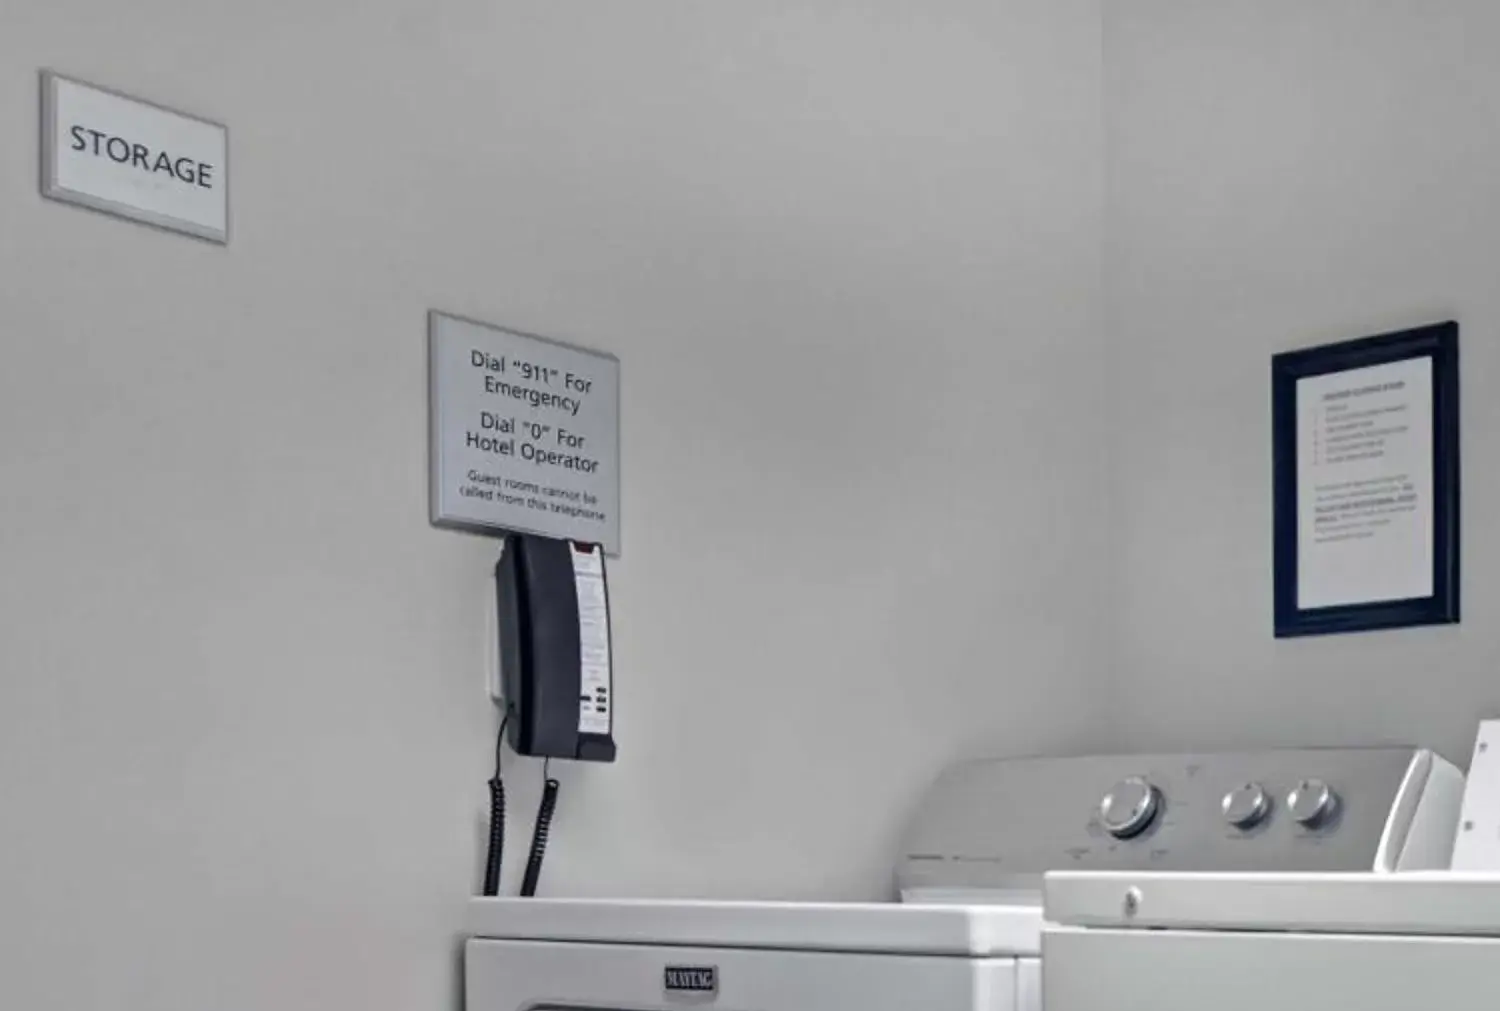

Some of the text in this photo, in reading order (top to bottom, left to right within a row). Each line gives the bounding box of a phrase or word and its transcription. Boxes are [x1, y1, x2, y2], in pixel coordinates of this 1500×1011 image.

[71, 125, 213, 189] STORAGE
[471, 349, 505, 373] Dial
[564, 373, 593, 394] For
[484, 375, 581, 416] Emergency
[480, 411, 515, 434] Dial
[557, 428, 585, 450] For
[466, 431, 600, 473] Hotel Operator
[459, 485, 494, 501] called
[497, 491, 526, 507] from
[527, 497, 548, 512] this
[467, 469, 598, 504] Guest rooms cannot be
